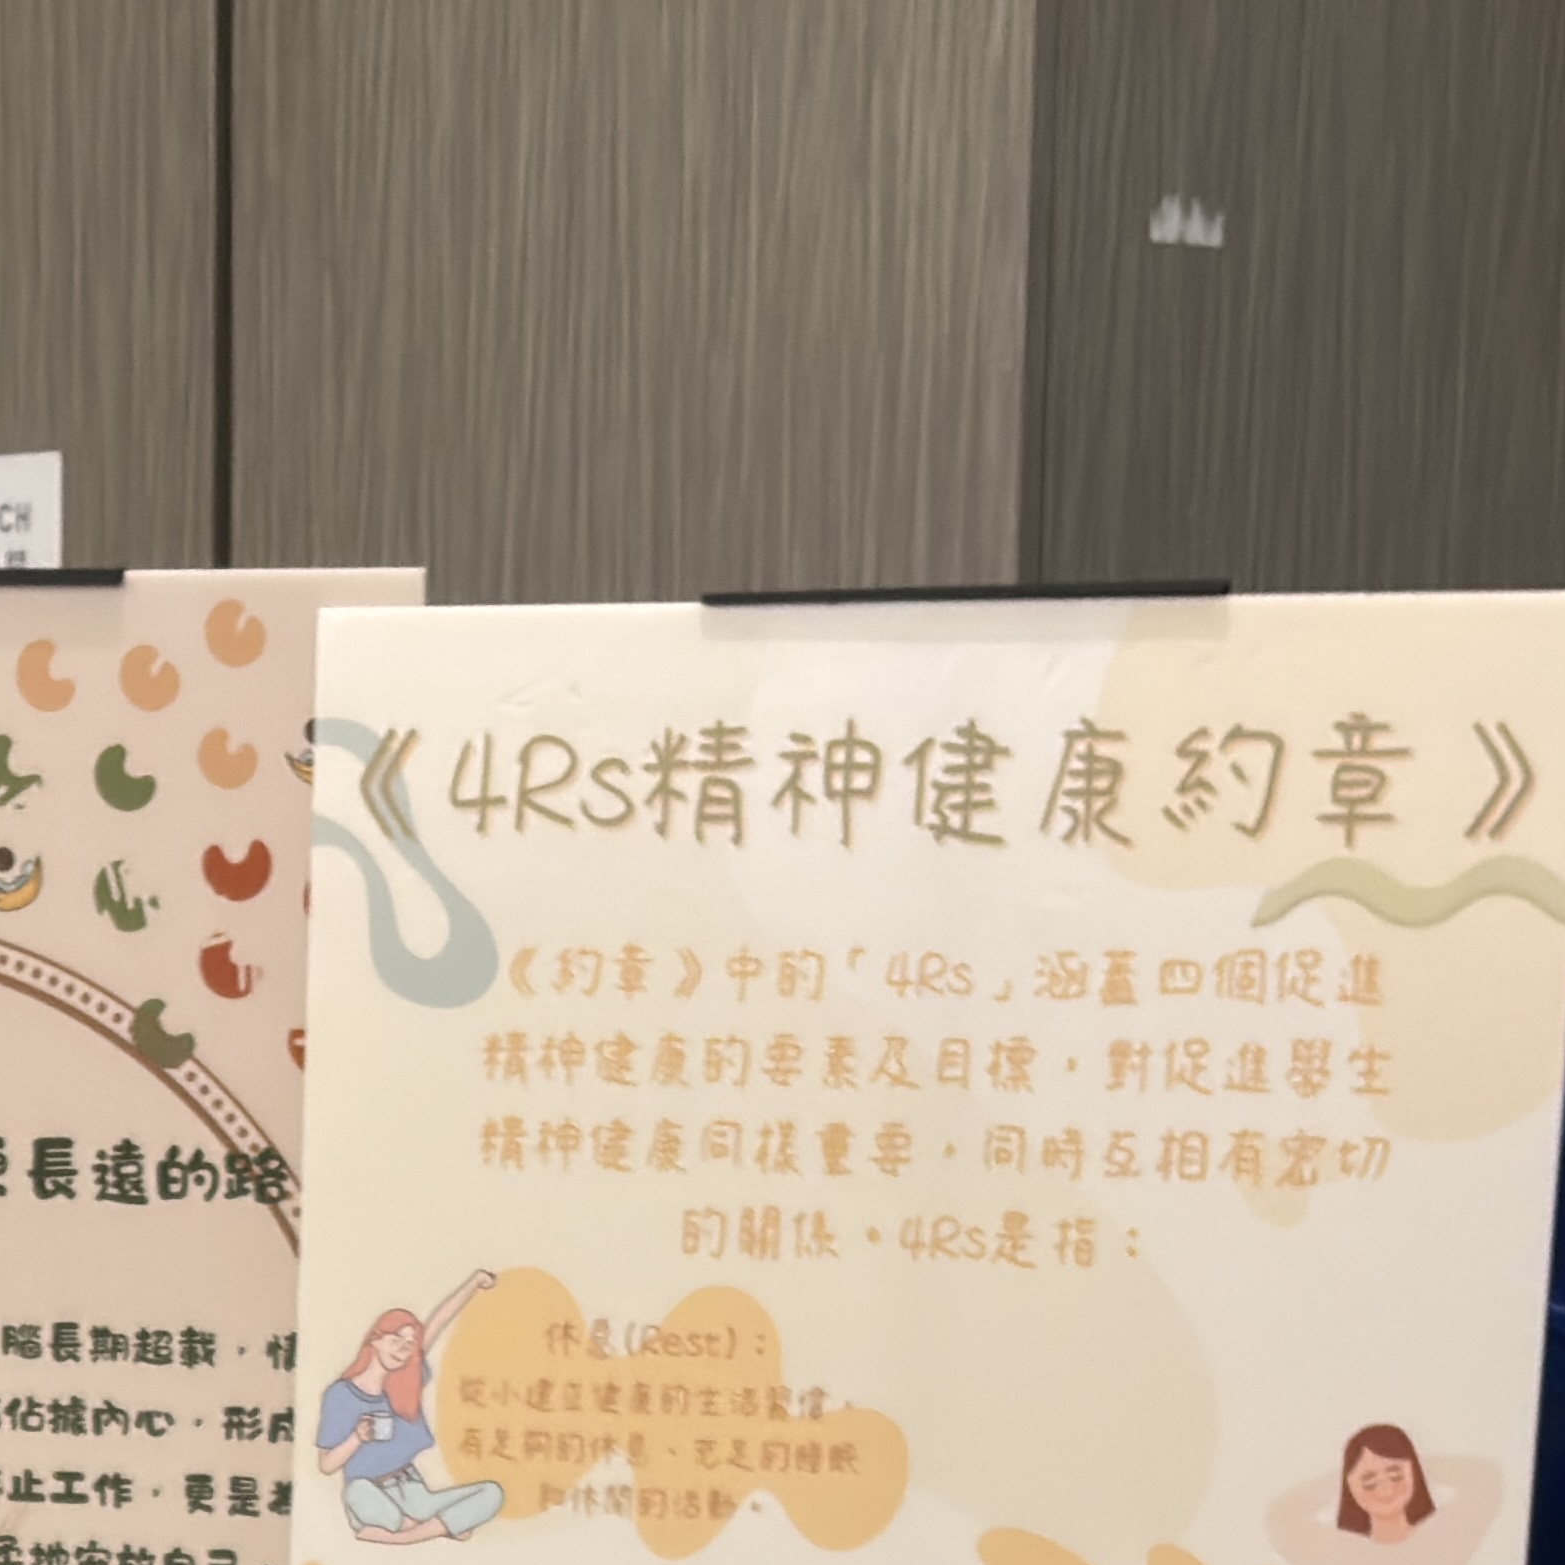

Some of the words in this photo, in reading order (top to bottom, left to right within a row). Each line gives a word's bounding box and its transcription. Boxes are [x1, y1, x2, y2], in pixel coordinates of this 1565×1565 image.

[358, 712, 1538, 850] 《4Rs精神健康約章》
